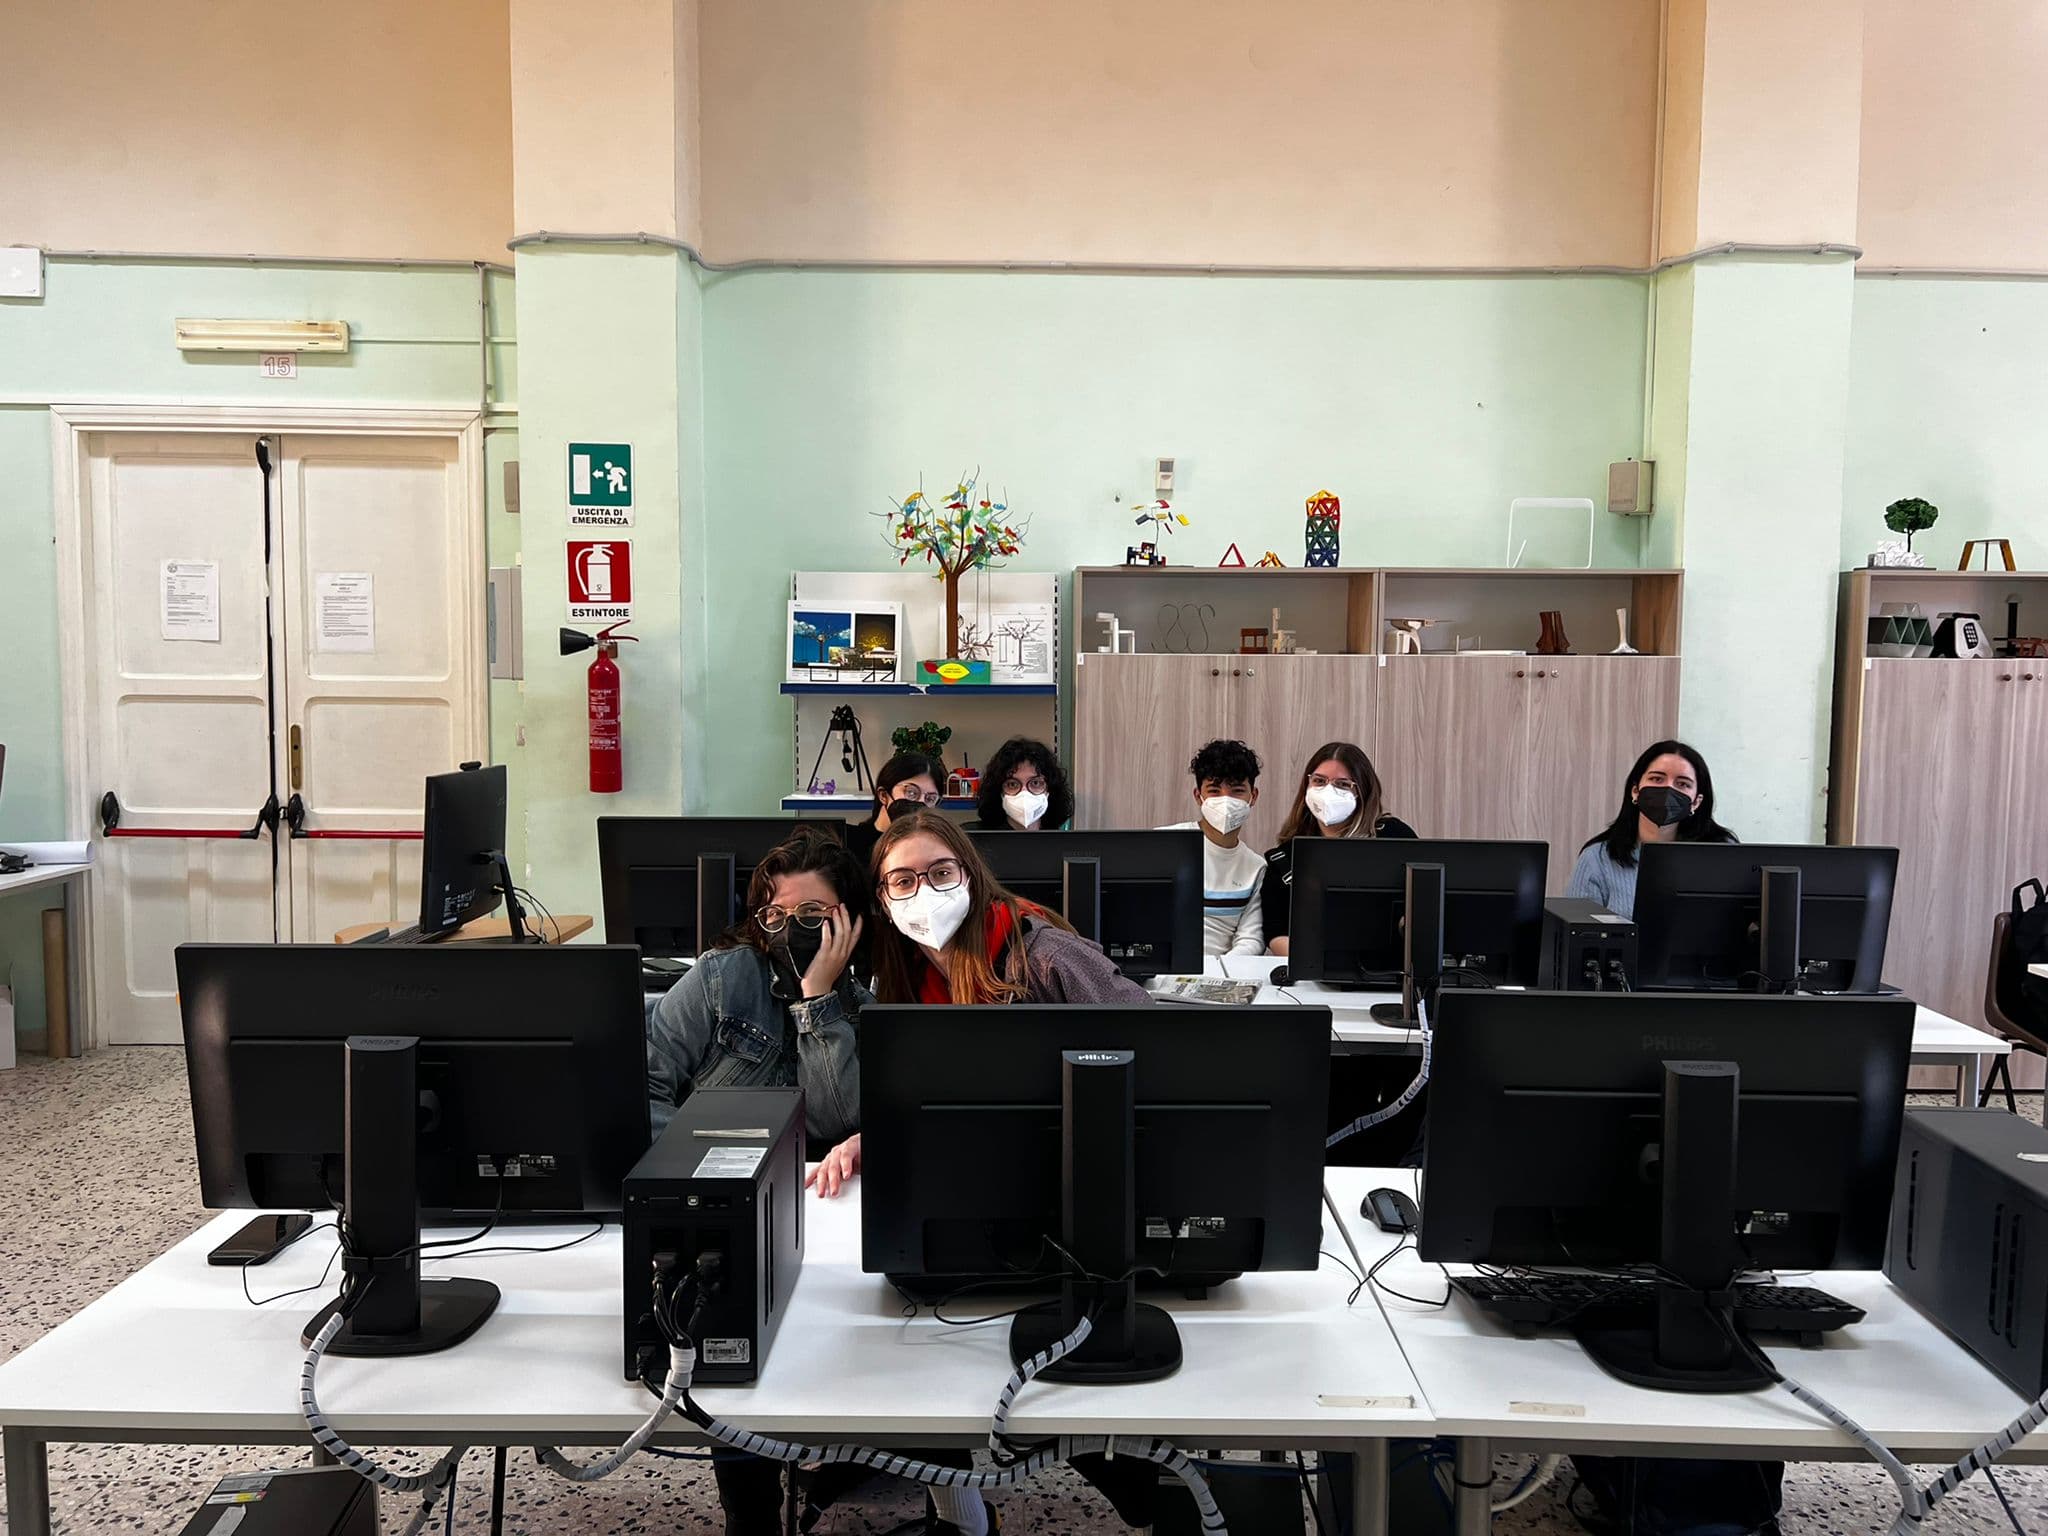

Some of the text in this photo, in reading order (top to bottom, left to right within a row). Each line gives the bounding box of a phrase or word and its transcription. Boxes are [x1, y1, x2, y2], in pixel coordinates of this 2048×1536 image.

[264, 356, 291, 376] 15
[577, 508, 623, 516] USCITA DI
[572, 516, 629, 525] EMERGENZA
[572, 608, 630, 617] ESTINTORE
